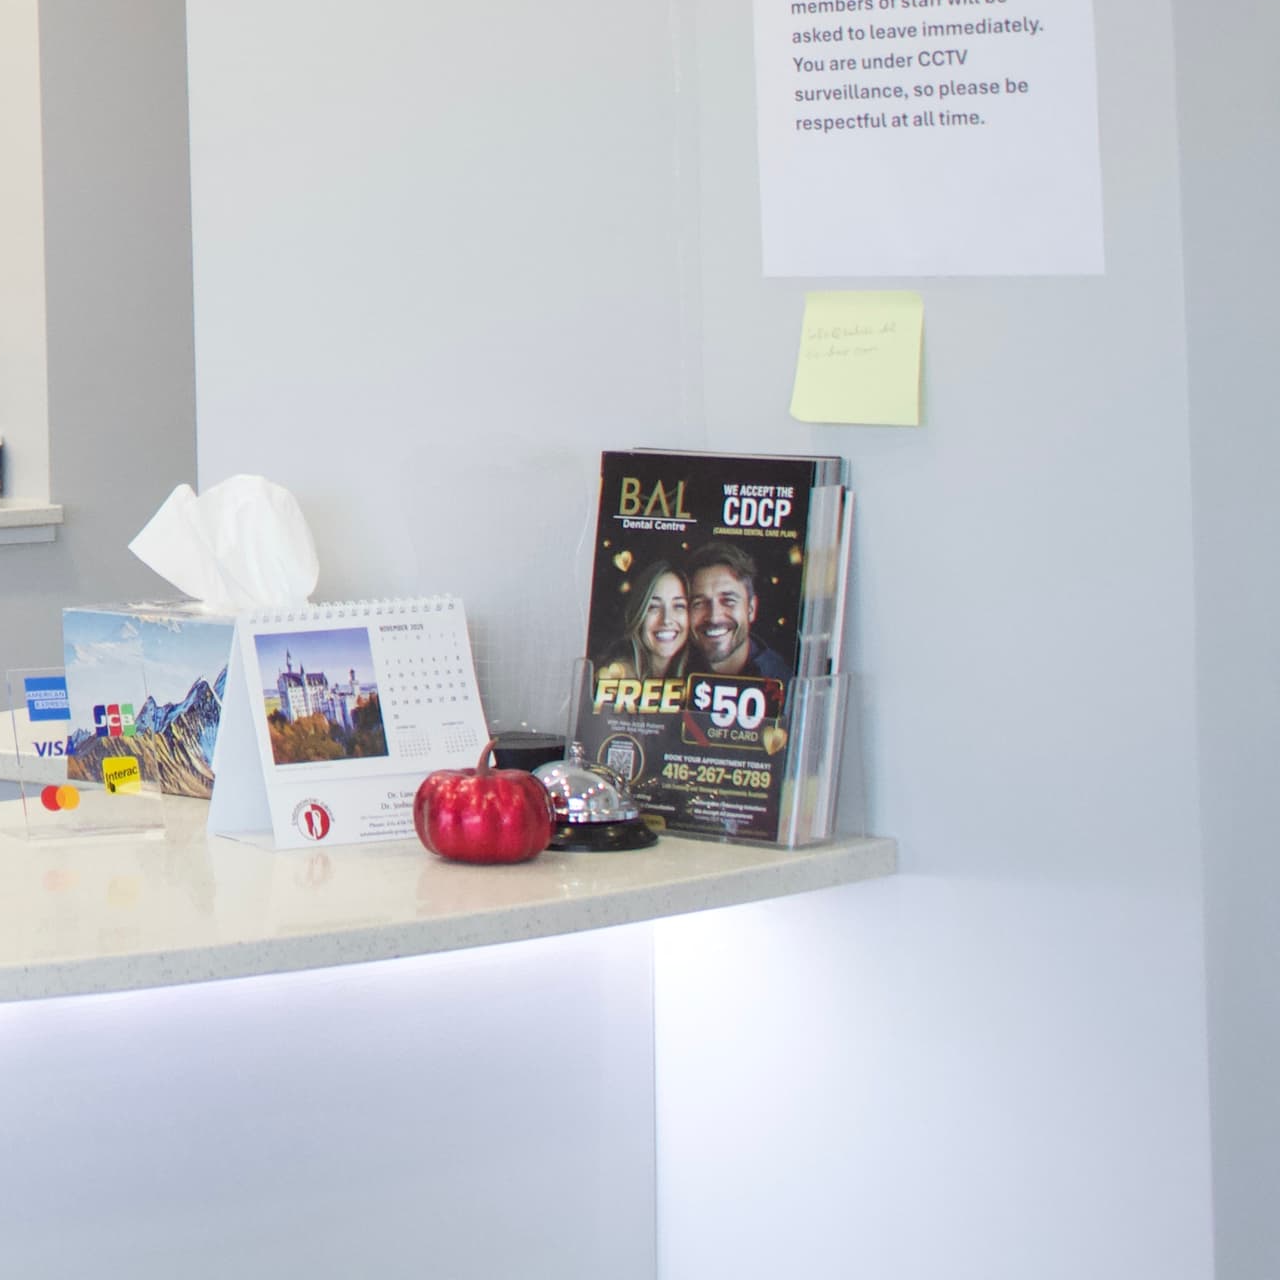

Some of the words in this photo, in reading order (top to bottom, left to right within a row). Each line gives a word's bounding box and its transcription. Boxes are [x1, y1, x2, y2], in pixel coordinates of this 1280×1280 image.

[792, 27, 842, 44] asked
[847, 26, 864, 41] to
[870, 23, 917, 40] leave
[922, 17, 1043, 37] immediately.
[793, 57, 824, 72] You
[829, 57, 856, 71] are
[862, 53, 913, 69] under
[918, 50, 968, 67] CCTV
[795, 82, 909, 102] surveillance,
[914, 83, 933, 97] so
[939, 78, 1000, 98] please
[1005, 77, 1028, 94] be
[796, 112, 887, 133] respectful
[892, 113, 908, 127] at
[913, 110, 934, 126] all
[939, 109, 985, 126] time.
[619, 477, 691, 518] BAL
[724, 485, 738, 496] WE
[740, 485, 775, 497] ACCEPT
[776, 486, 794, 498] THE
[723, 497, 791, 527] CDCP
[623, 519, 652, 529] Dental
[655, 521, 686, 531] Centre
[380, 624, 408, 632] NOVEMBER
[593, 679, 684, 715] FREE
[693, 681, 766, 729] $50
[707, 728, 729, 739] GIFT
[731, 729, 758, 742] CARD
[32, 740, 78, 757] VISA
[664, 753, 682, 761] BOOK
[684, 756, 702, 764] YOUR
[702, 757, 746, 768] APPOINTMENT
[747, 761, 771, 769] TODAY!
[105, 766, 138, 782] Interac
[662, 763, 771, 788] 416-267-6789
